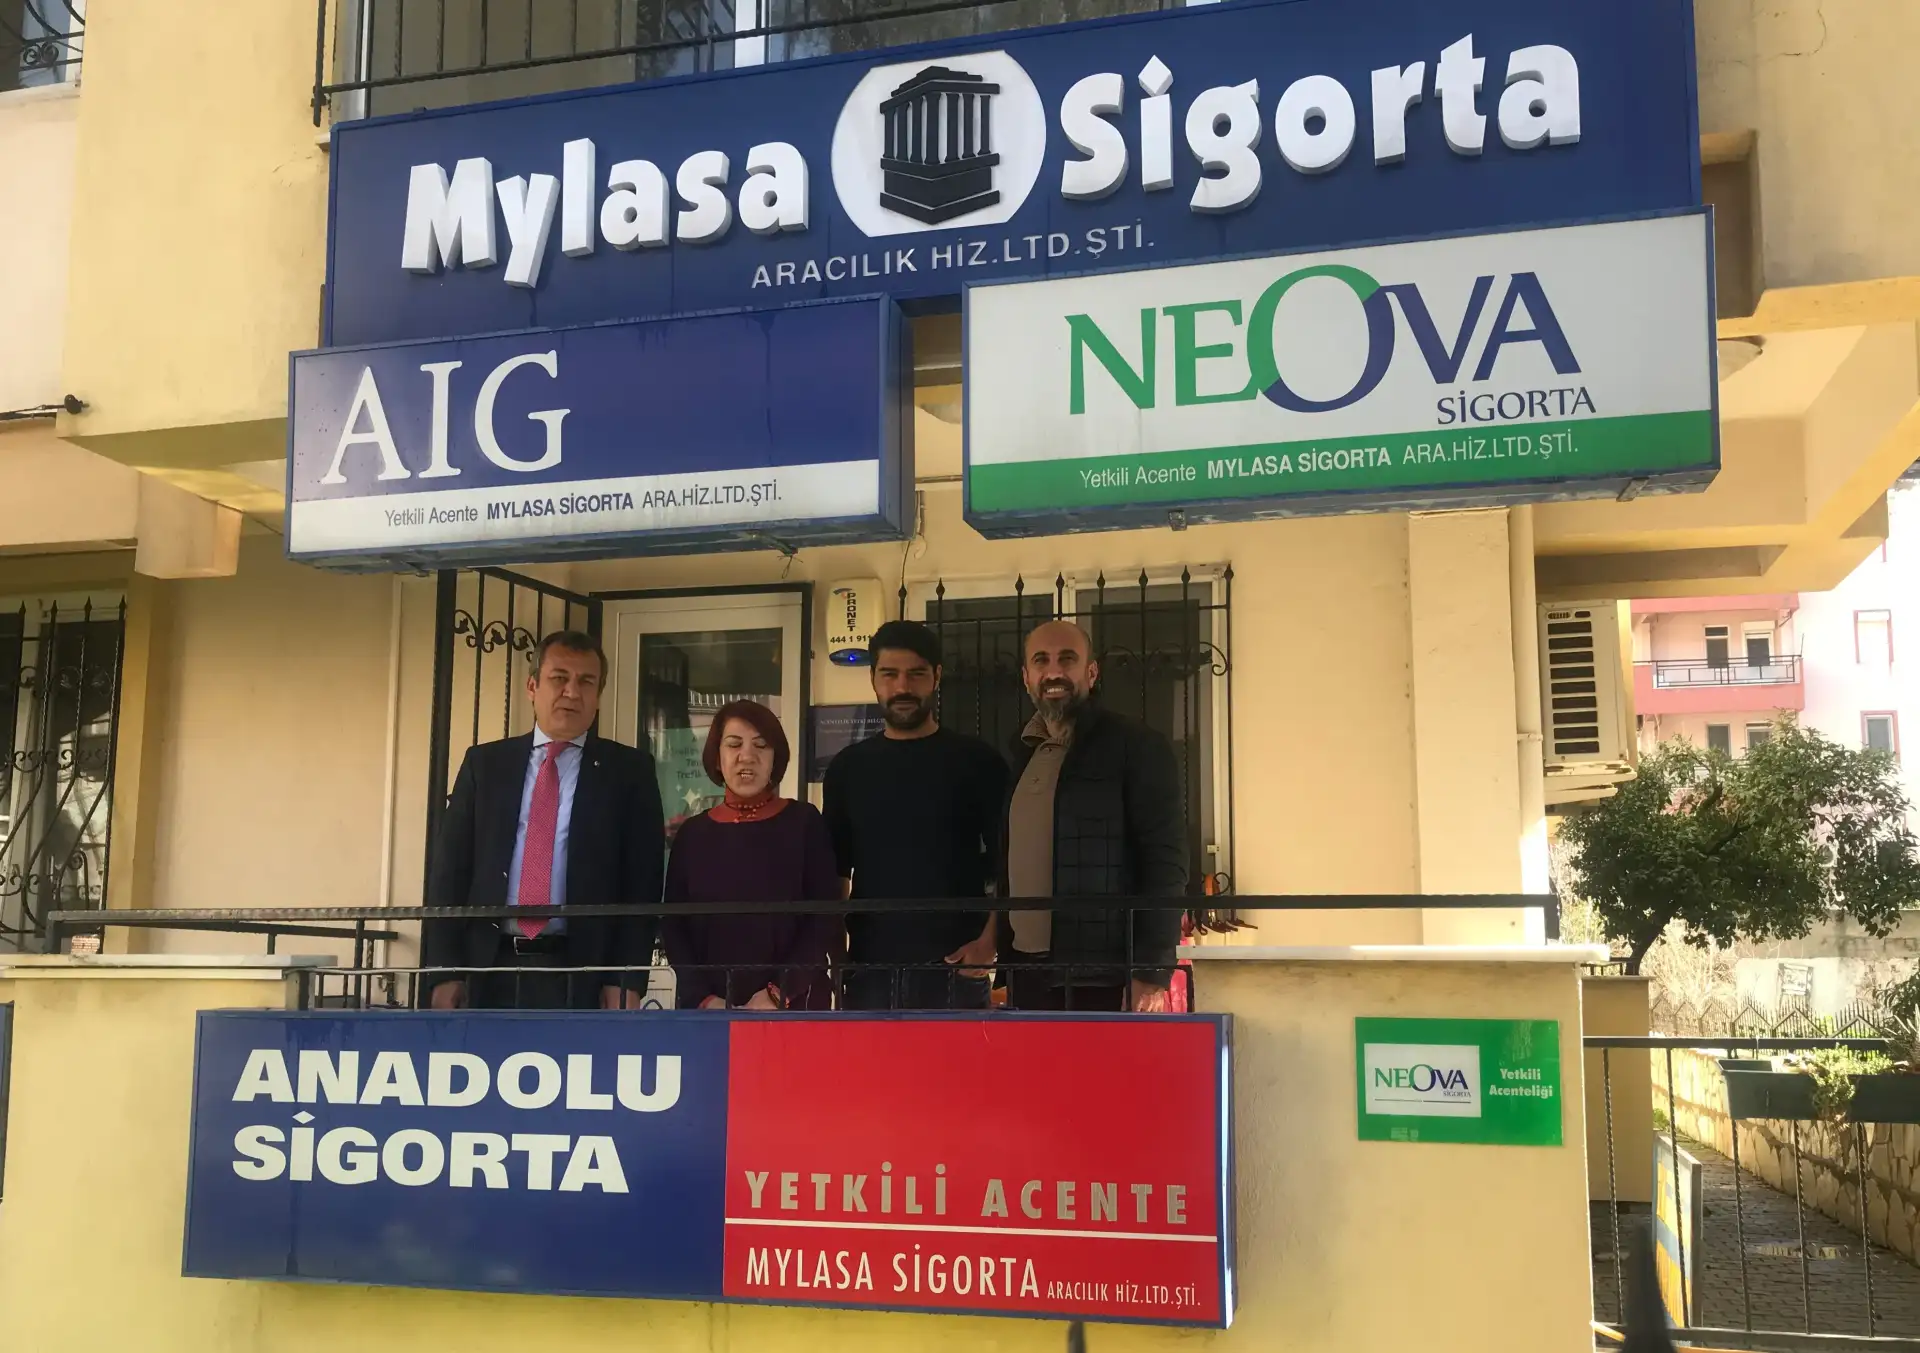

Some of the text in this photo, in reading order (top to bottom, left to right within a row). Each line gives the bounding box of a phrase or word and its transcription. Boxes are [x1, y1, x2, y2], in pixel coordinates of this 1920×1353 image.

[402, 137, 809, 288] Mylasa
[750, 218, 1155, 289] ARACILIK HİZ.LTD.ŞTİ.
[1064, 264, 1582, 414] NEOVA
[320, 350, 571, 485] AIG
[1437, 385, 1597, 425] SİGORTA
[1080, 429, 1580, 489] Yetkili Acente MYLASA SİGORTA ARA.HİZ.LTD.ŞTİ.
[384, 480, 783, 527] Yetkili Acente MYLASA SİGORTA ARA.HİZ.LTD.ŞTİ.
[847, 592, 857, 632] PRONET
[232, 1049, 682, 1112] ANADOLU
[1374, 1064, 1469, 1092] NEOVA
[1489, 1085, 1553, 1099] Acenteliği
[1500, 1068, 1541, 1080] Yetkili
[232, 1111, 630, 1194] SİGORTA
[744, 1161, 1188, 1225] YETKİLİ ACENTE
[745, 1243, 1201, 1309] MYLASA SİGORTA ARACILIK HİZ.LTD.ŞTİ.
